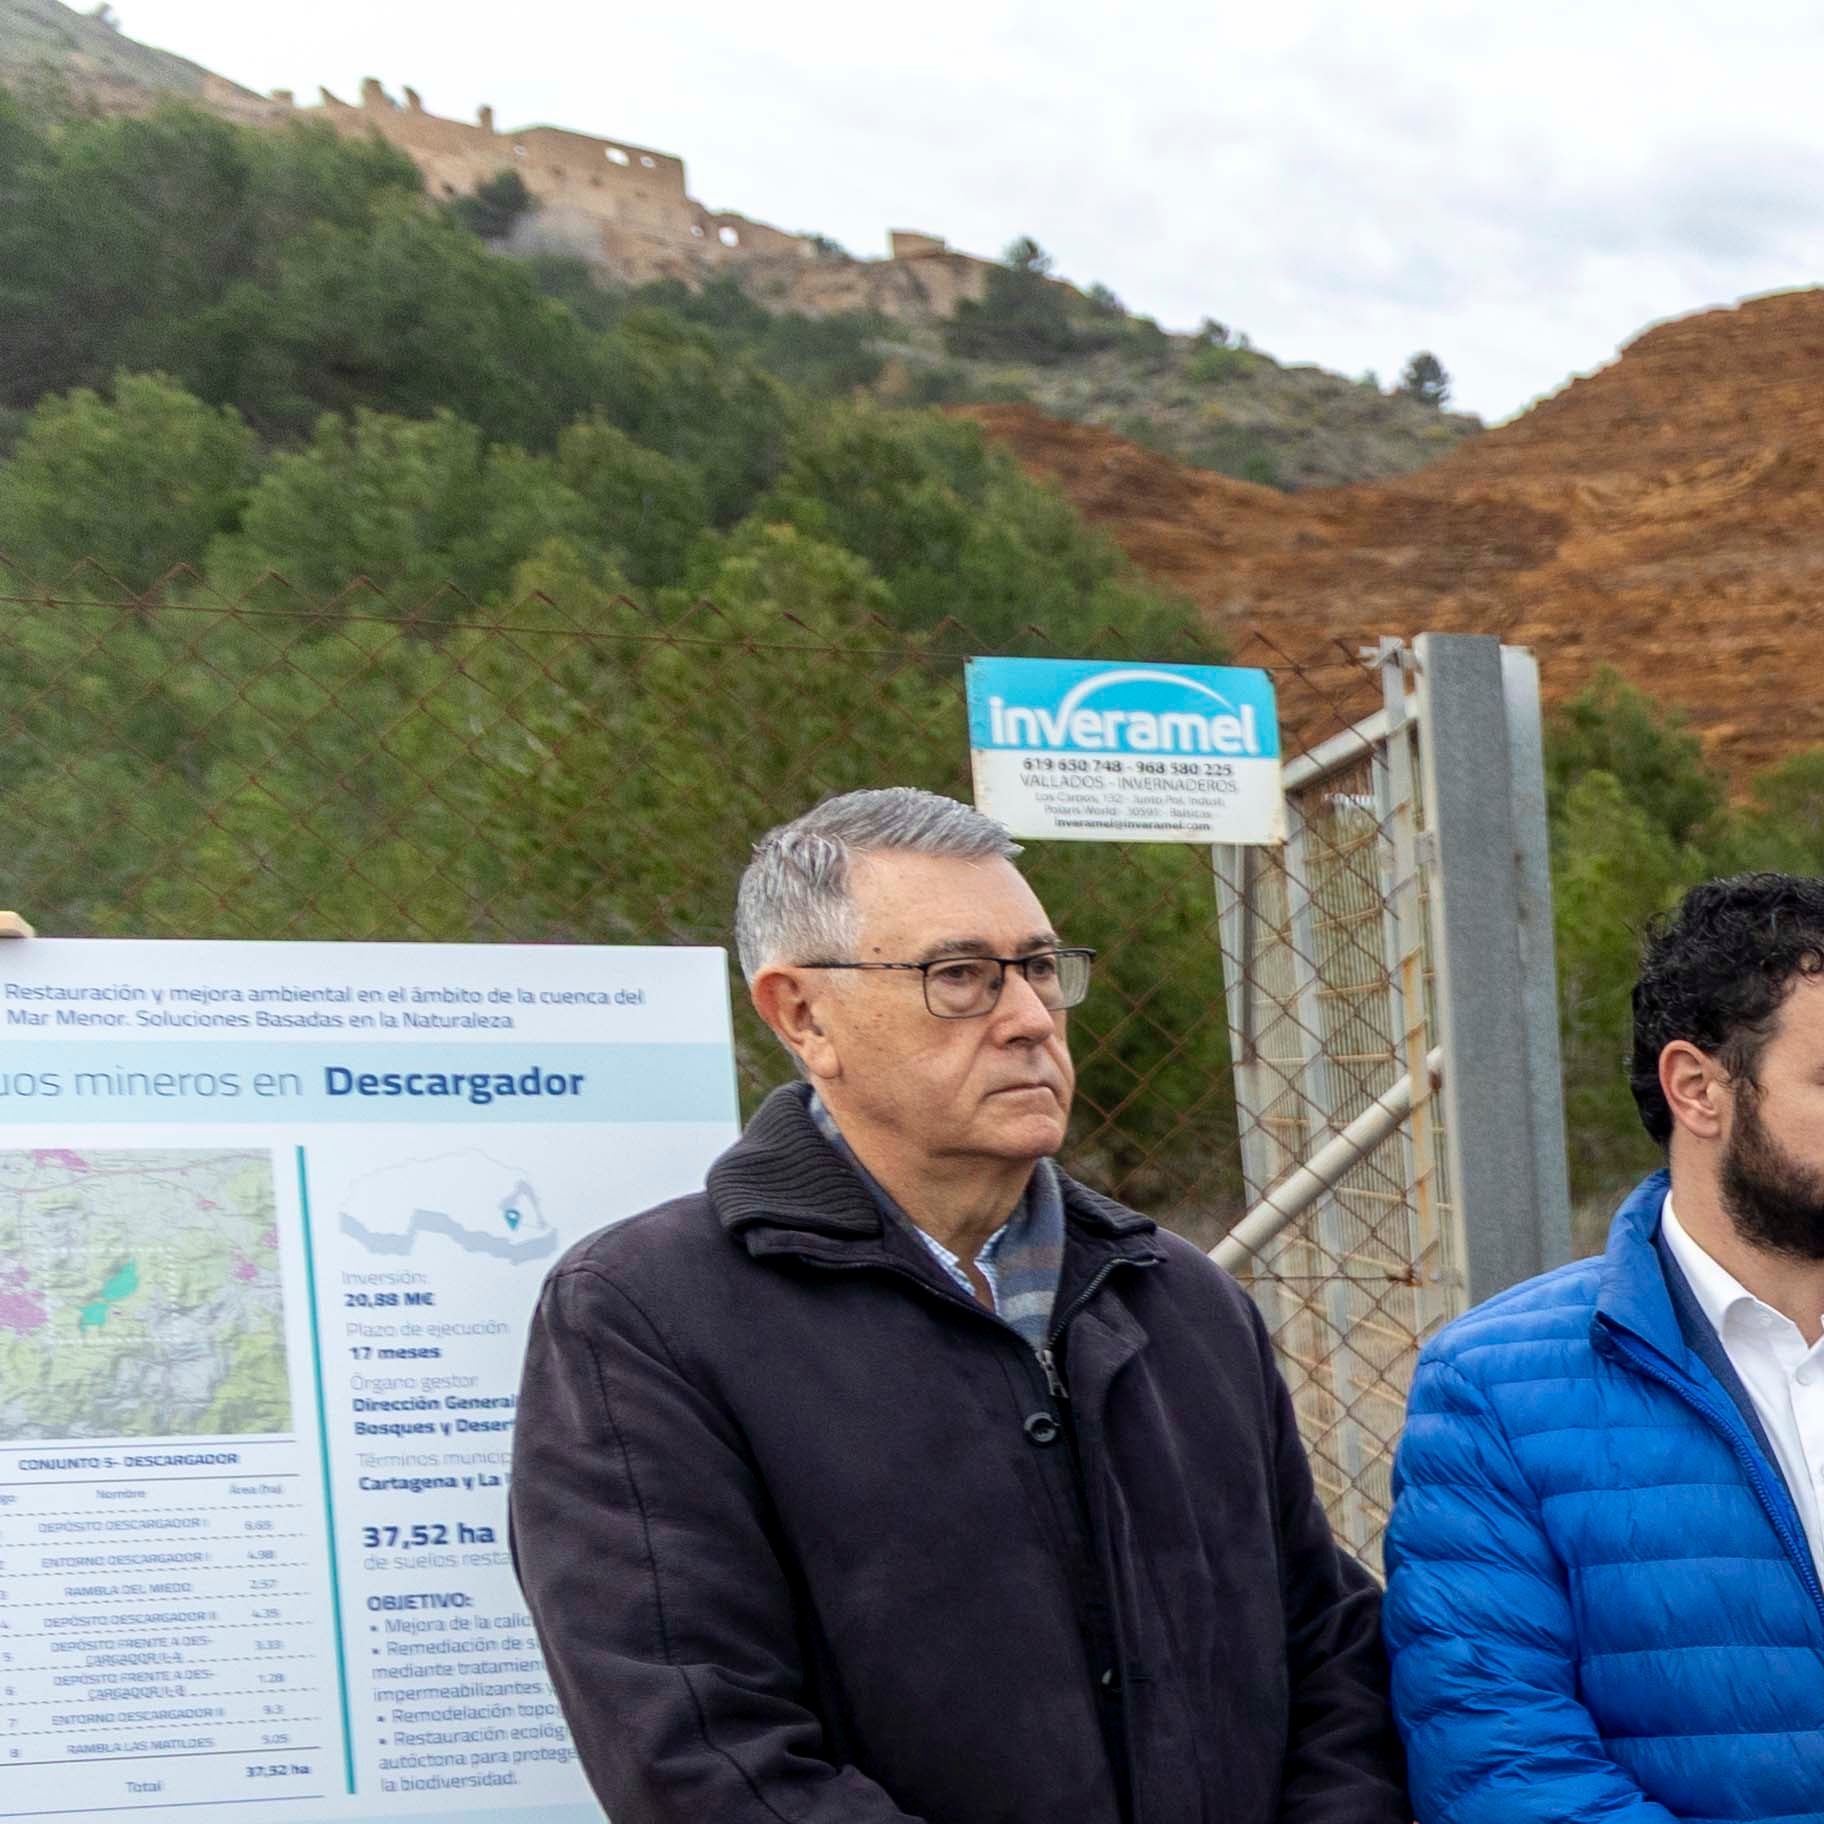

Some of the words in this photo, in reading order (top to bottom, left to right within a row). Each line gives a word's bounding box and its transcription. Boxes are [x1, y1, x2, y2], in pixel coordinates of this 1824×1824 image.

[988, 693, 1261, 753] inveramel
[1020, 774, 1104, 789] VALLADOS
[1118, 777, 1237, 793] INVERNADEROS
[4, 983, 146, 1002] Restauración
[151, 988, 162, 1005] y
[170, 985, 243, 1006] mejora
[248, 984, 352, 1004] ambiental
[357, 989, 384, 1003] en
[388, 986, 408, 1003] el
[411, 986, 482, 1004] ámbito
[487, 987, 513, 1004] de
[517, 987, 536, 1005] la
[539, 990, 611, 1005] cuenca
[614, 988, 646, 1005] del
[7, 1009, 50, 1026] Mar
[56, 1010, 131, 1027] Menor.
[136, 1009, 251, 1028] Soluciones
[256, 1011, 343, 1028] Basadas
[348, 1015, 376, 1029] en
[379, 1011, 398, 1029] la
[403, 1012, 515, 1029] Naturaleza
[74, 1063, 242, 1097] mineros
[253, 1072, 304, 1097] en
[324, 1066, 585, 1106] Descargador
[341, 1270, 428, 1286] Inversión:
[344, 1292, 400, 1308] 20,88
[403, 1292, 437, 1307] M€
[346, 1321, 396, 1337] Plazo
[399, 1322, 422, 1337] de
[427, 1319, 510, 1339] ejecución
[348, 1346, 372, 1360] 17
[377, 1347, 443, 1360] meses
[350, 1371, 417, 1395] Órgano
[421, 1373, 479, 1392] gestor
[352, 1395, 442, 1413] Dirección
[354, 1420, 437, 1439] Bosques
[440, 1424, 452, 1438] y
[456, 1418, 514, 1433] Deser
[18, 1457, 101, 1471] CONJUNTO
[124, 1452, 240, 1468] DESCARGADOR
[356, 1449, 439, 1468] Términos
[359, 1474, 459, 1494] Cartagena
[462, 1476, 474, 1491] y
[478, 1472, 500, 1487] La
[96, 1488, 147, 1500] Nombre
[362, 1523, 449, 1550] 37,52
[457, 1522, 497, 1544] ha
[364, 1554, 388, 1571] de
[394, 1552, 457, 1570] suelos
[462, 1551, 513, 1567] resta
[64, 1583, 120, 1598] RAMBLA
[122, 1583, 147, 1596] DEL
[149, 1581, 193, 1595] MIEDO
[366, 1592, 474, 1612] OBJETIVO:
[110, 1610, 207, 1625] DESCARGADOR
[385, 1618, 445, 1636] Mejora
[449, 1615, 470, 1631] de
[475, 1614, 489, 1629] la
[117, 1637, 169, 1651] FRENTE
[386, 1635, 498, 1656] Remediación
[502, 1635, 522, 1651] de
[120, 1671, 171, 1683] FRENTE
[372, 1661, 453, 1680] mediante
[457, 1657, 546, 1675] tratamien
[373, 1680, 543, 1704] impermeabilizantes
[51, 1712, 116, 1727] ENTORNO
[117, 1708, 214, 1723] DESCARGADOR
[391, 1704, 513, 1724] Remodelación
[517, 1702, 562, 1721] topo
[393, 1730, 507, 1747] Restauración
[510, 1722, 568, 1743] ecológ
[66, 1741, 123, 1755] RAMBLA
[150, 1737, 215, 1751] MATILDES
[378, 1753, 466, 1771] autóctona
[470, 1751, 509, 1770] para
[513, 1746, 580, 1767] protege
[126, 1780, 162, 1794] Total
[380, 1777, 397, 1794] la
[400, 1771, 520, 1792] biodiversidad.
